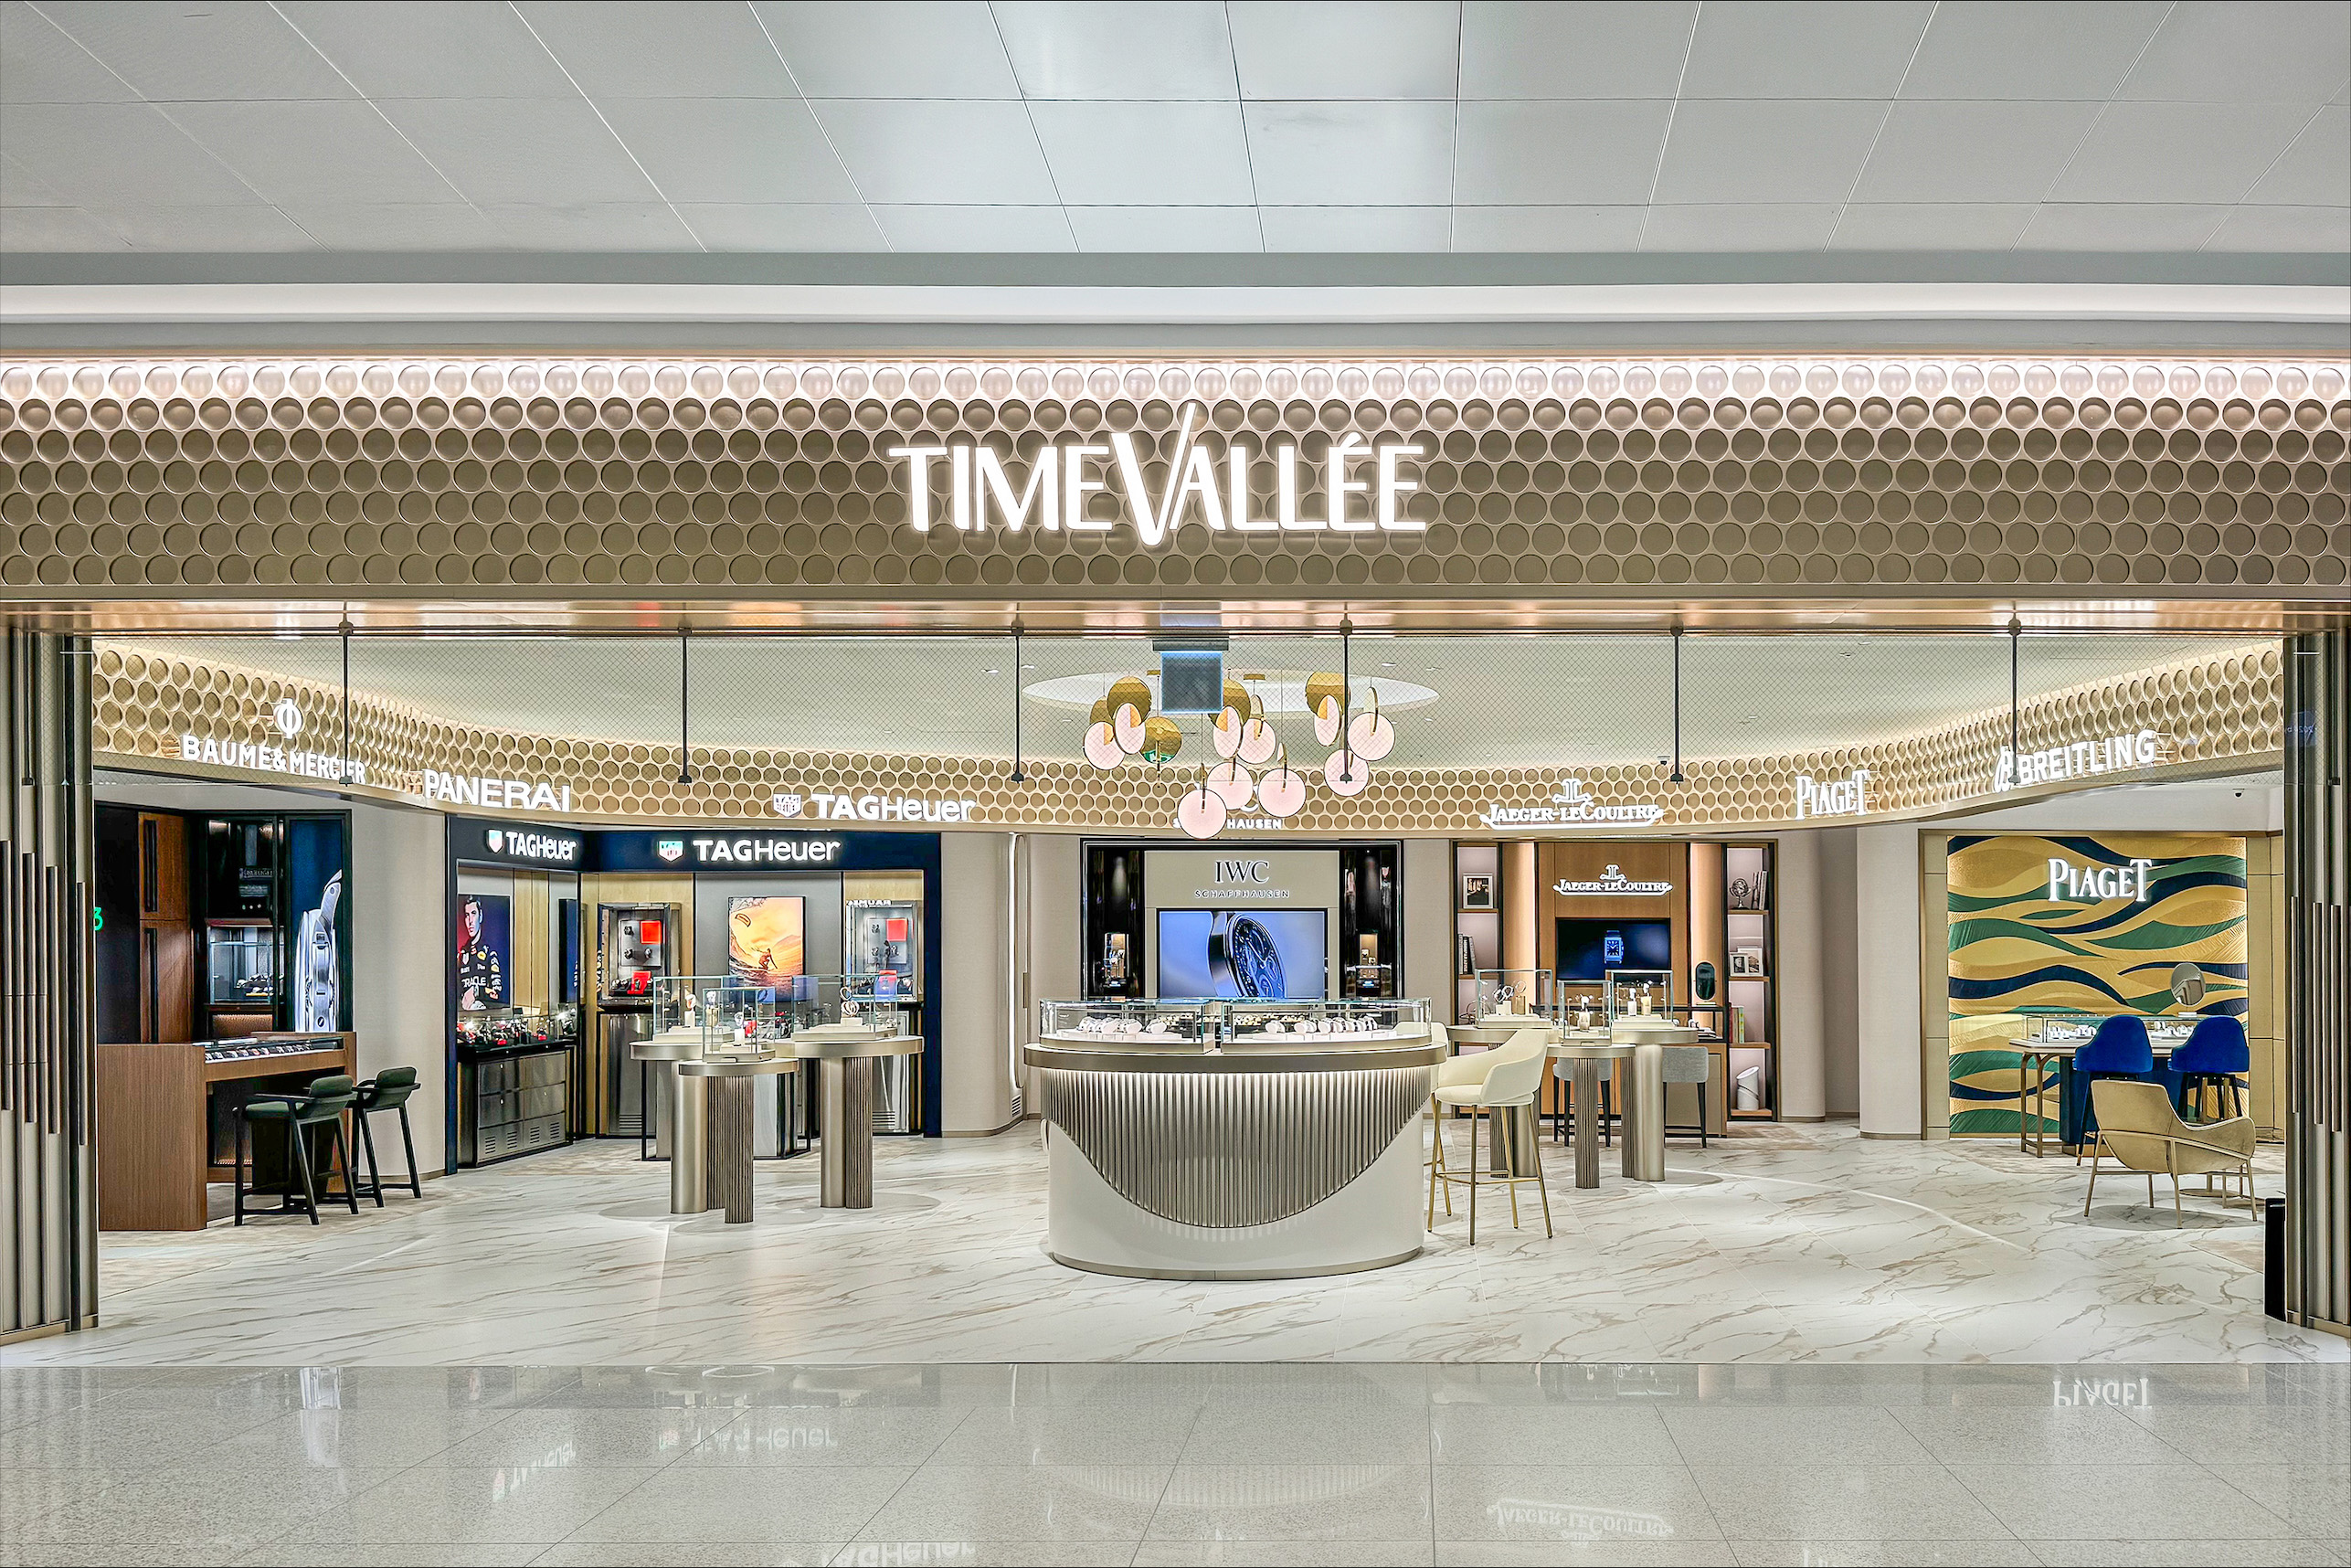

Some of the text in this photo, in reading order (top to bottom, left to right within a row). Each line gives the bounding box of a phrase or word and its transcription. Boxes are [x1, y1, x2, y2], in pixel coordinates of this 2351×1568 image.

[2017, 730, 2158, 786] BREITLING
[423, 768, 571, 812] PANERAI
[1795, 768, 1869, 821] PIAGET
[1194, 889, 1290, 898] SCHAFFHAUSEN
[1214, 860, 1270, 884] IWC
[2047, 858, 2153, 903] PIAGET
